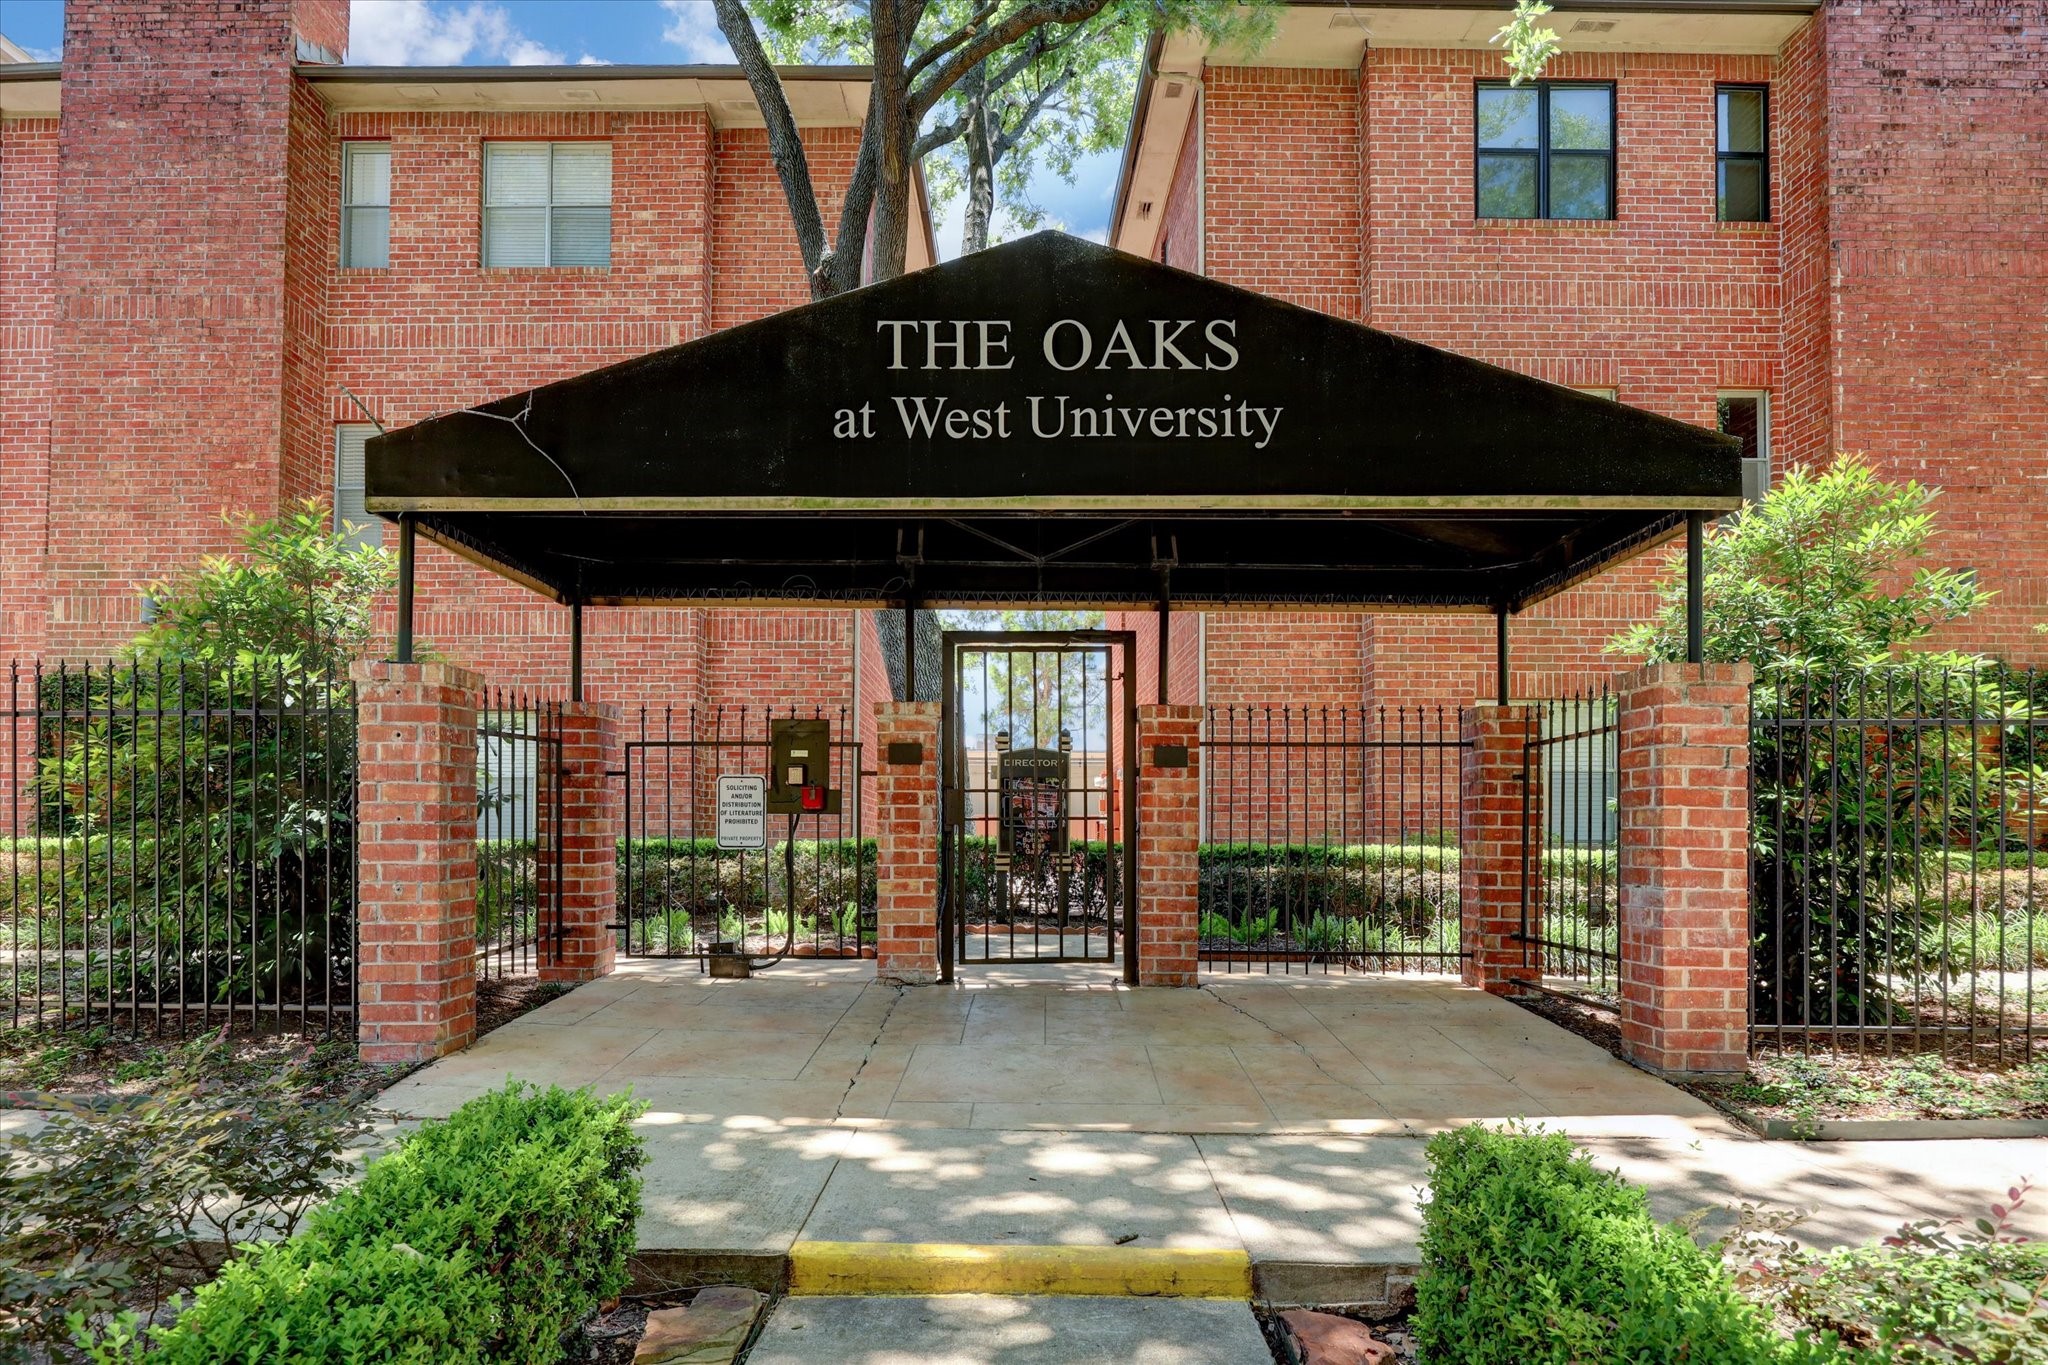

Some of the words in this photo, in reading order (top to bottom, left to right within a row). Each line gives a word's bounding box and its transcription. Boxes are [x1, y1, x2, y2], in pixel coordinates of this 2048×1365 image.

[876, 320, 1015, 370] THE
[1042, 318, 1240, 371] OAKS
[833, 398, 876, 439] at
[891, 396, 1012, 440] West
[1025, 393, 1284, 449] University
